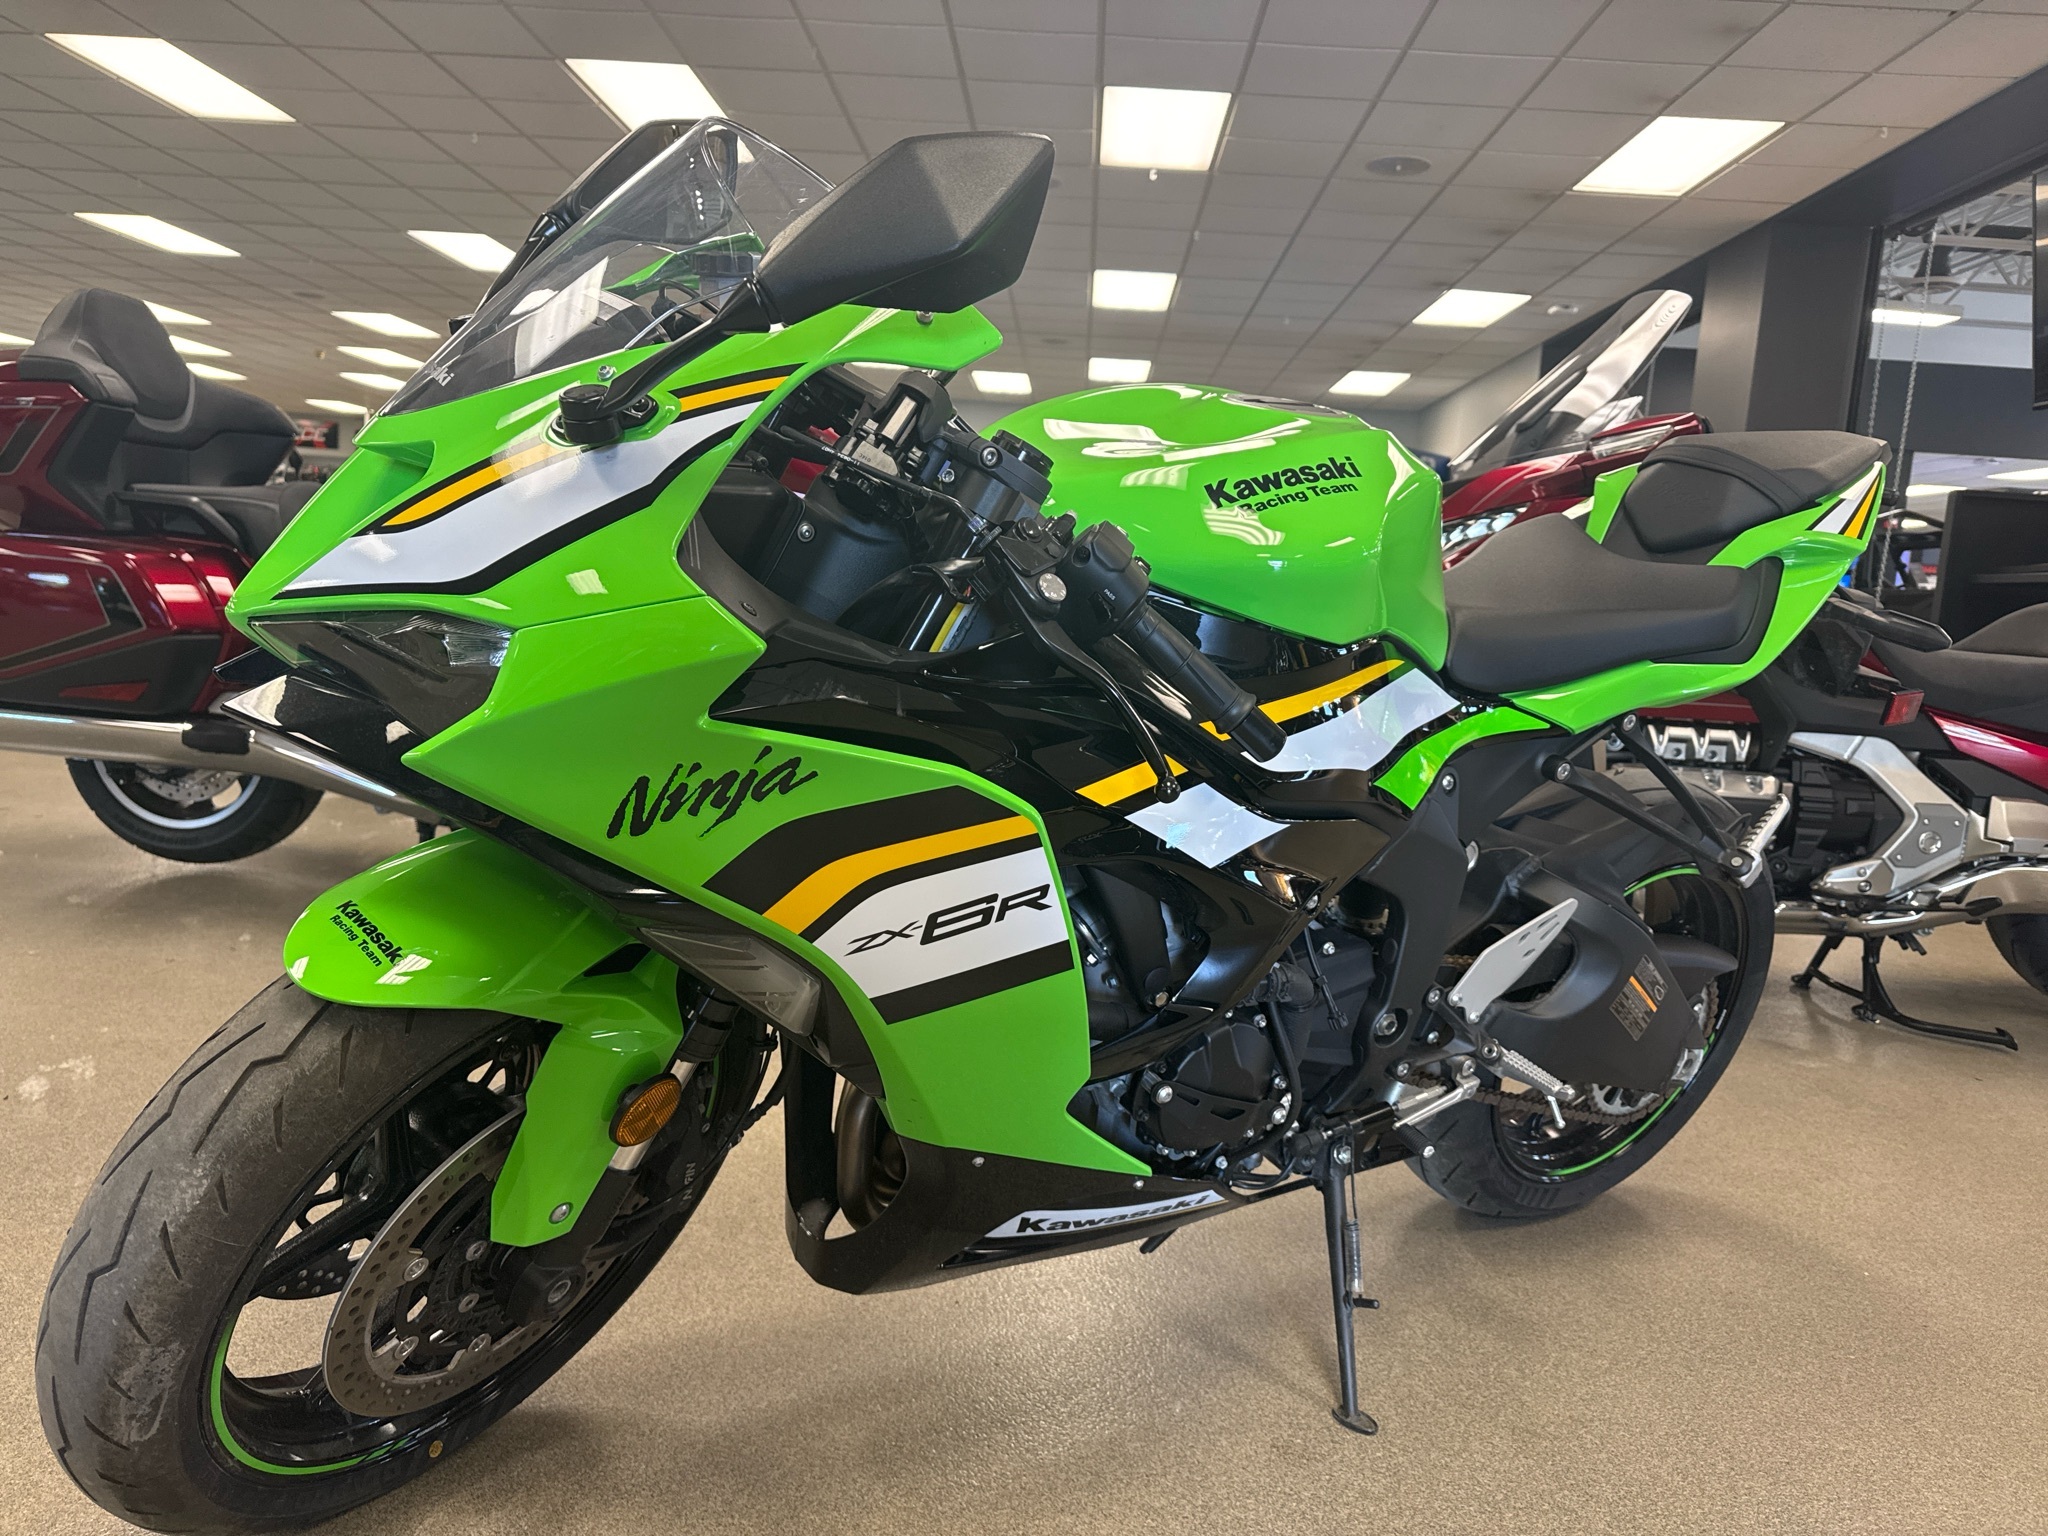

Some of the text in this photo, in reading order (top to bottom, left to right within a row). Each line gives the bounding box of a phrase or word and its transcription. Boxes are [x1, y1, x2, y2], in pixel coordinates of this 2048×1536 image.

[1203, 456, 1363, 509] Kawasaki
[1238, 482, 1359, 513] Racing Team
[1103, 588, 1116, 601] PASS
[606, 745, 819, 839] Ninja
[329, 914, 383, 967] Racing Team
[844, 883, 1053, 957] ZX-6R
[1016, 1194, 1210, 1234] Kawasaki
